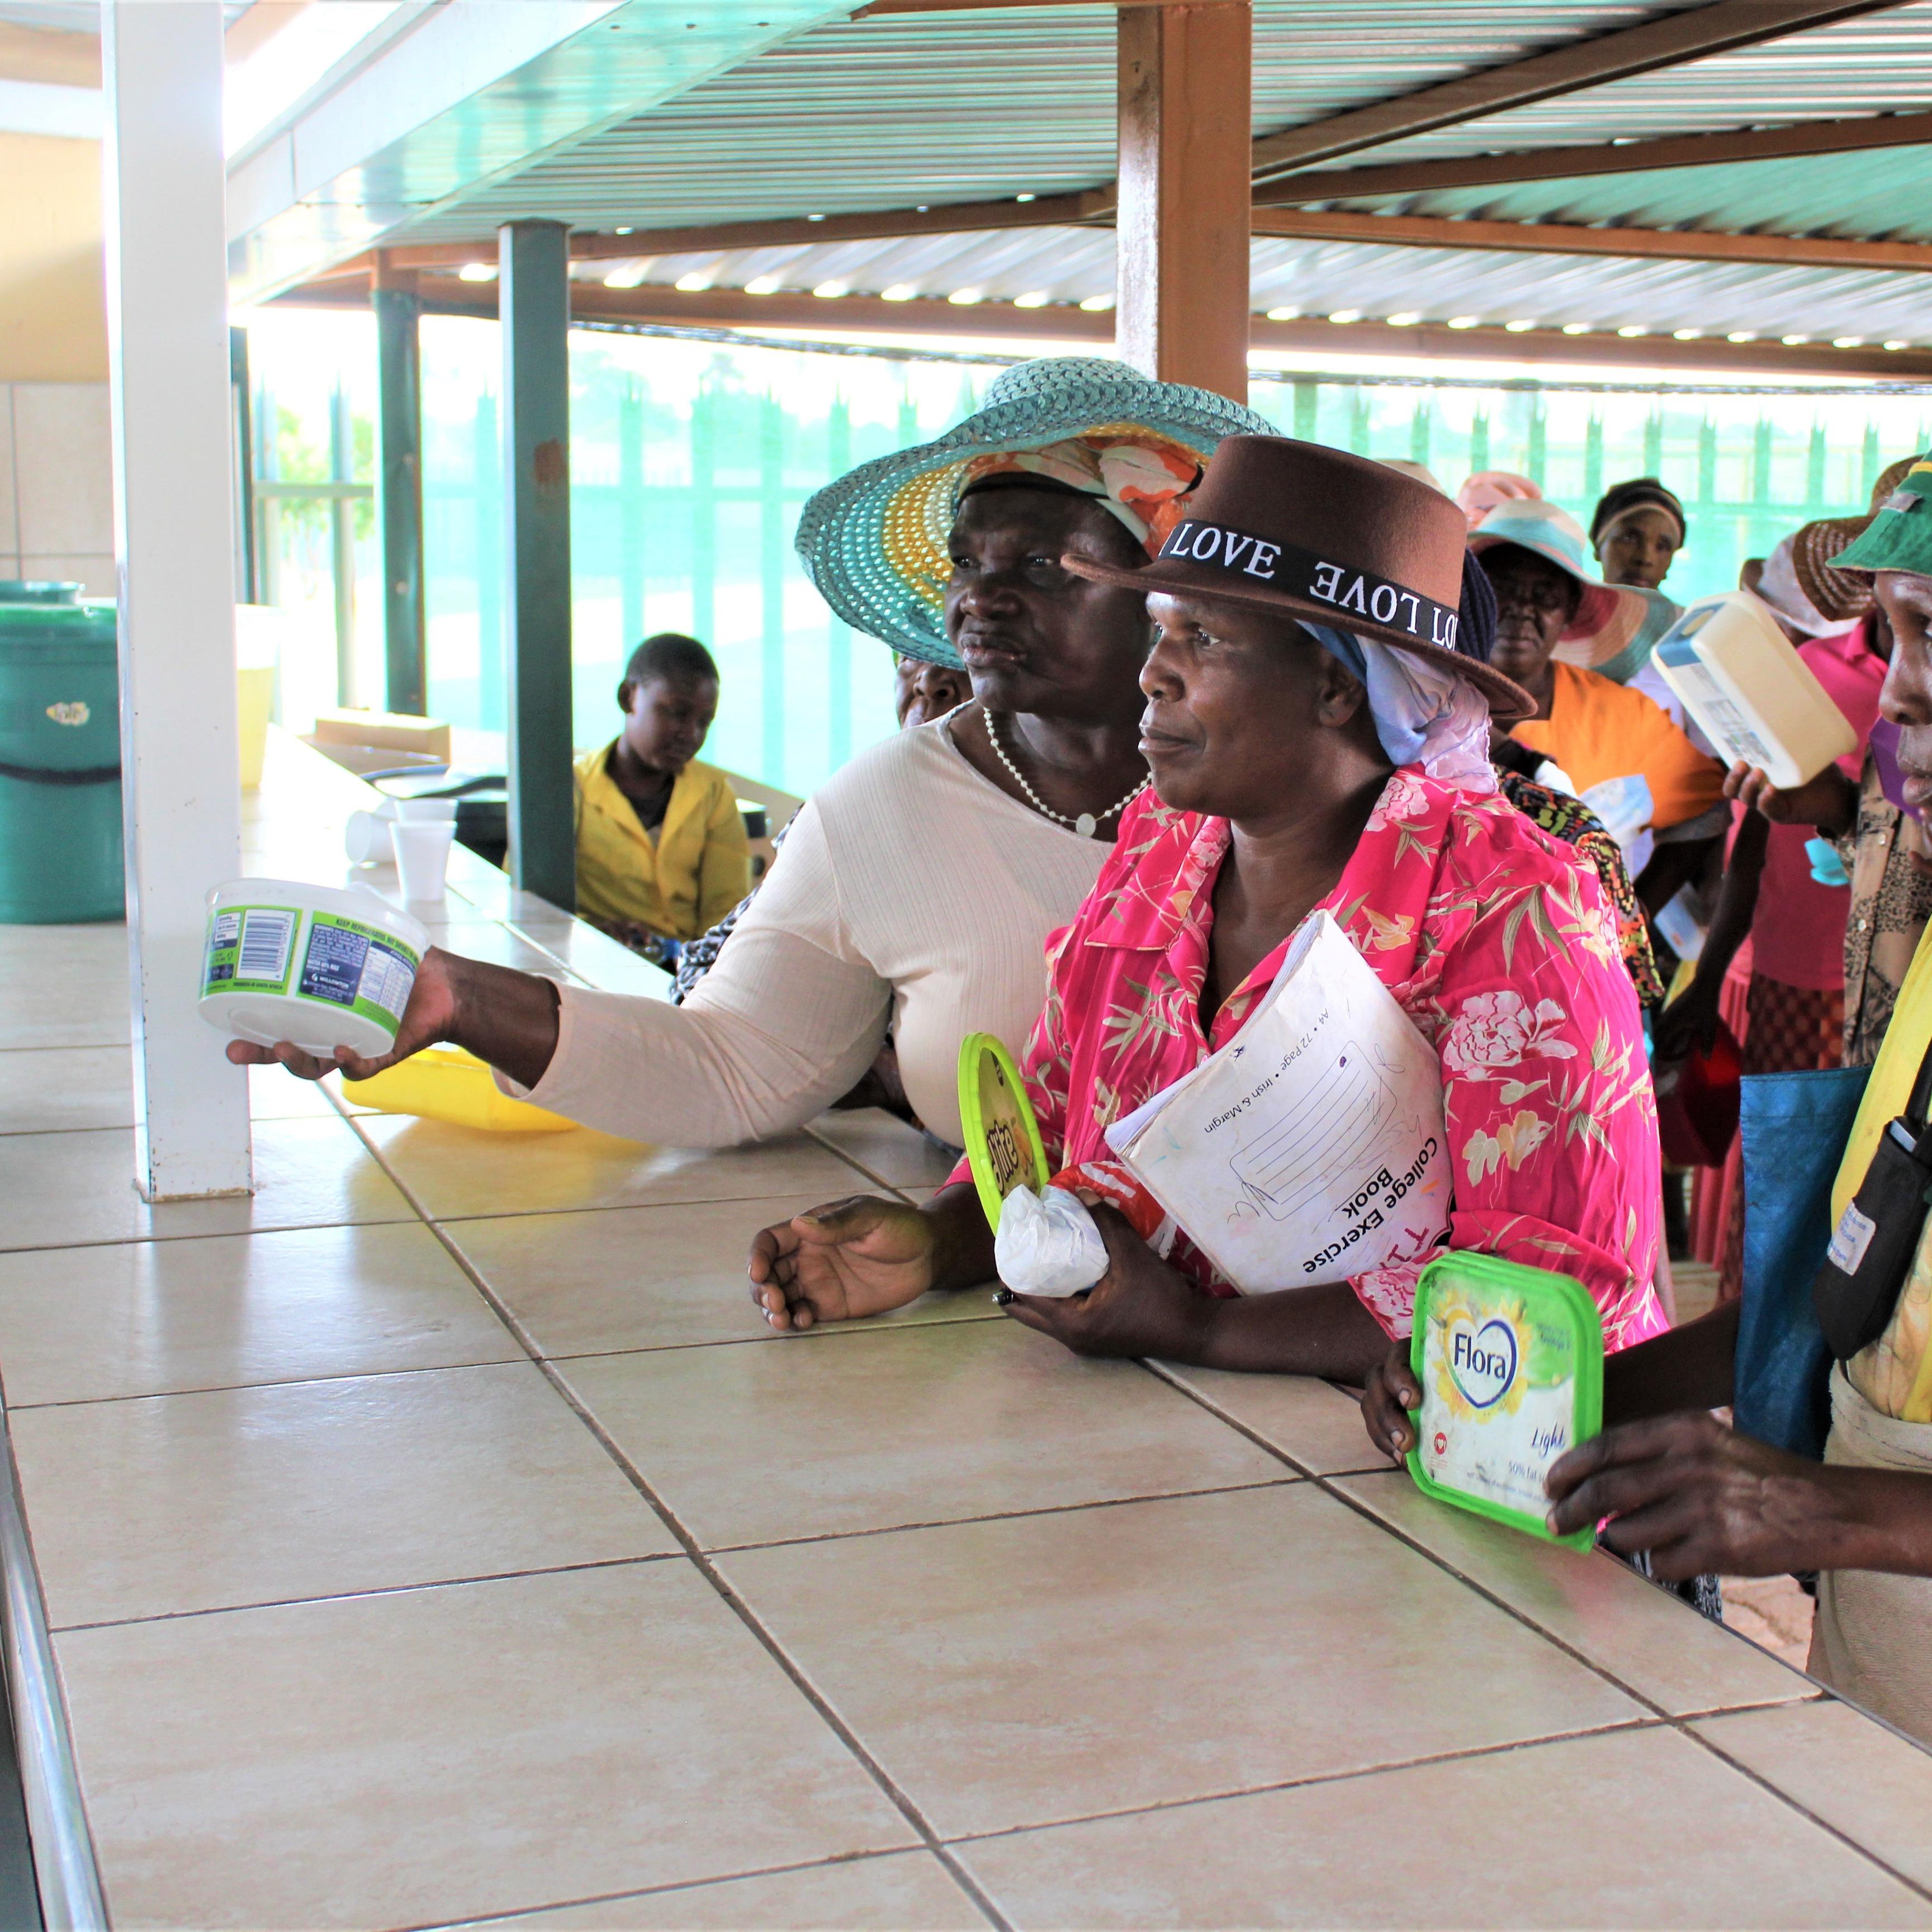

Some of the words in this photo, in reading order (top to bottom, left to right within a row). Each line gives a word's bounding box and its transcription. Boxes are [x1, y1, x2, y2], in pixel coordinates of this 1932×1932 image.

[1170, 523, 1281, 579] LOVE
[1309, 561, 1420, 634] LOVE
[1431, 607, 1459, 652] LO
[337, 918, 350, 928] KEEP
[319, 976, 349, 990] WILLOWTON
[1318, 1007, 1329, 1025] A4
[1299, 1033, 1314, 1049] 72
[1280, 1047, 1302, 1071] Page
[1252, 1078, 1274, 1100] Irish
[1242, 1097, 1252, 1108] &
[1204, 1104, 1242, 1134] Margin
[1384, 1137, 1437, 1209] College
[1342, 1167, 1393, 1219] Book
[1303, 1210, 1384, 1273] Exercise
[1453, 1333, 1507, 1380] Flora
